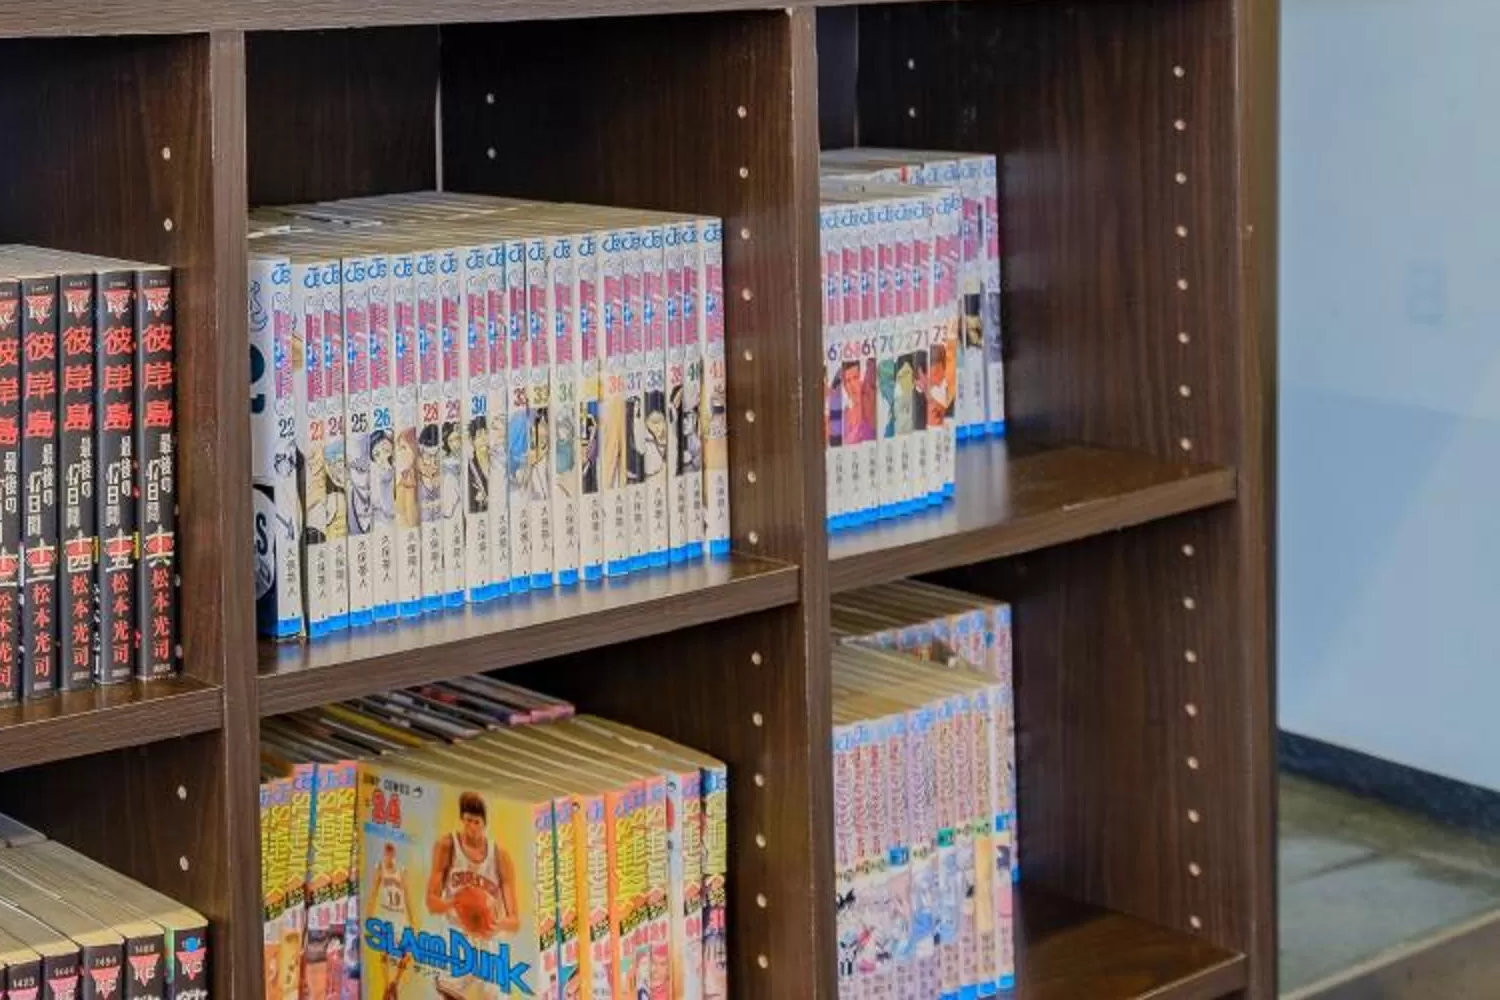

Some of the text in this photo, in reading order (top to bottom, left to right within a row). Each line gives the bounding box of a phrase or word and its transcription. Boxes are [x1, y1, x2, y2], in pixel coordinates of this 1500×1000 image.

[24, 332, 55, 438] 彼岸島
[63, 326, 93, 432] 彼岸島
[103, 326, 133, 431] 彼岸島
[143, 323, 173, 428] 彼岸島
[26, 538, 55, 583] 十三
[64, 530, 93, 573] 十四
[105, 528, 133, 572] 十五
[145, 524, 174, 567] 十六
[32, 584, 51, 677] 松本光司
[71, 574, 90, 667] 松本光司
[111, 573, 130, 664] 松本光司
[152, 568, 170, 660] 松本光司
